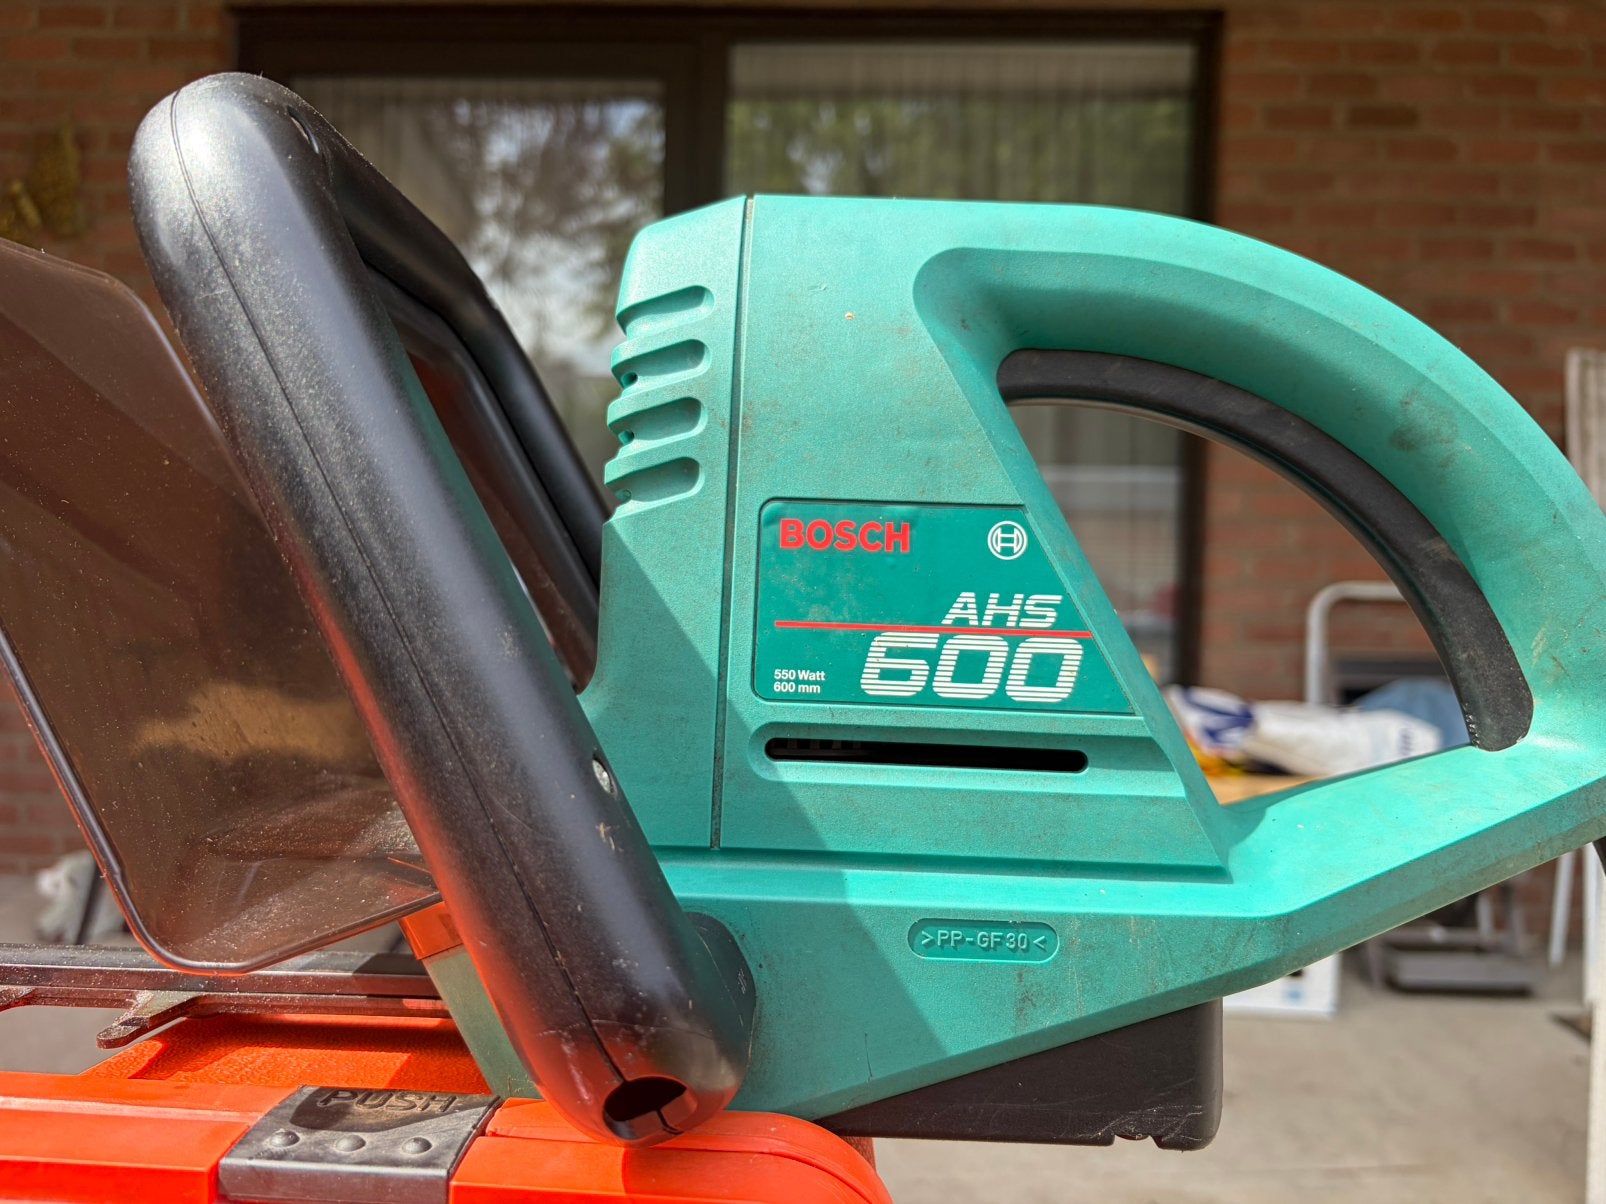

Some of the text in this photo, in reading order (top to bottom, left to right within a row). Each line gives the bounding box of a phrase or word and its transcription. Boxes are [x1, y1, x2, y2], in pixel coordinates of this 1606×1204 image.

[779, 518, 911, 553] BOSCH
[941, 591, 1063, 628] AHS
[774, 669, 826, 681] 550 Watt
[860, 631, 1084, 703] 600
[773, 682, 821, 694] 600 mm
[316, 1088, 458, 1113] PUSH
